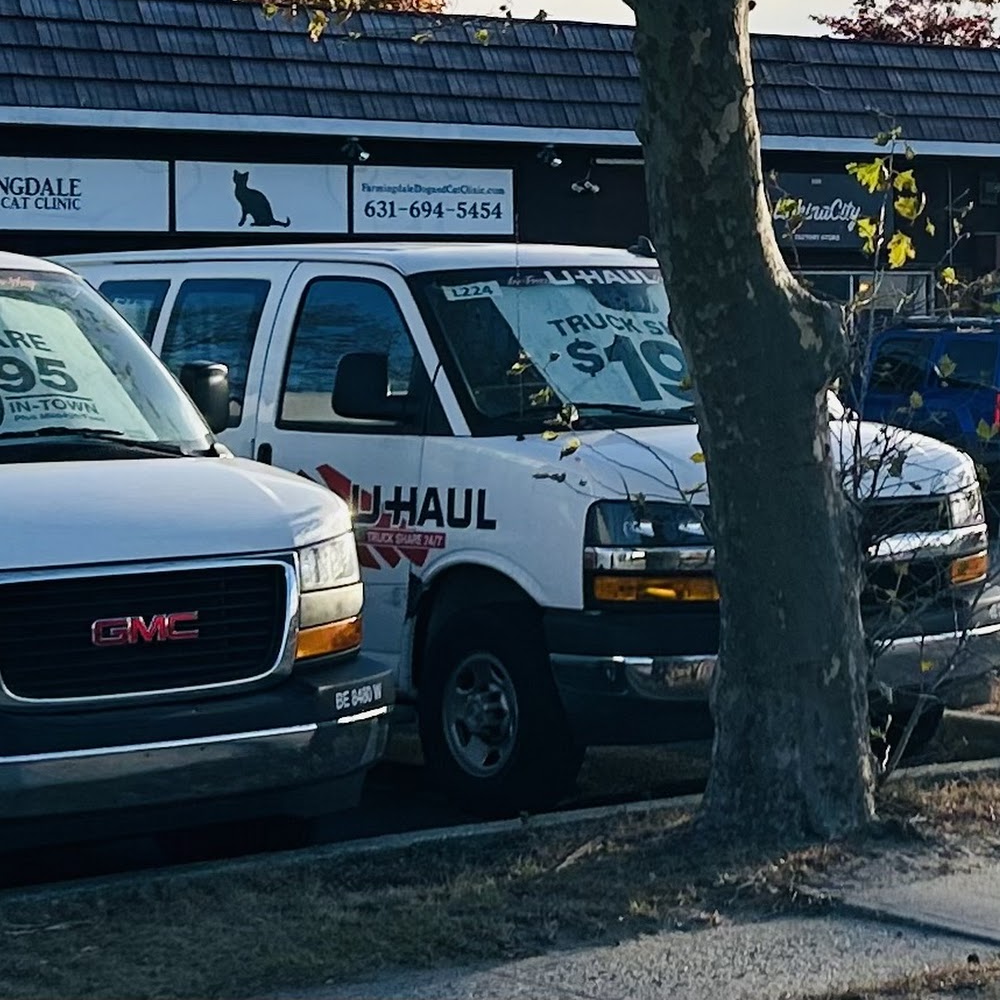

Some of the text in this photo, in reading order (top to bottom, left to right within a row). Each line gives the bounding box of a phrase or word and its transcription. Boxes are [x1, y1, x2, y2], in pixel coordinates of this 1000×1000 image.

[1, 197, 81, 210] CAT CLINIC
[364, 200, 502, 219] 631-694-5454
[543, 270, 664, 285] U-HAUL
[547, 313, 642, 336] TRUCK
[9, 399, 99, 414] IN-TOWN
[352, 484, 497, 530] U-HAUL
[91, 611, 199, 646] GMC
